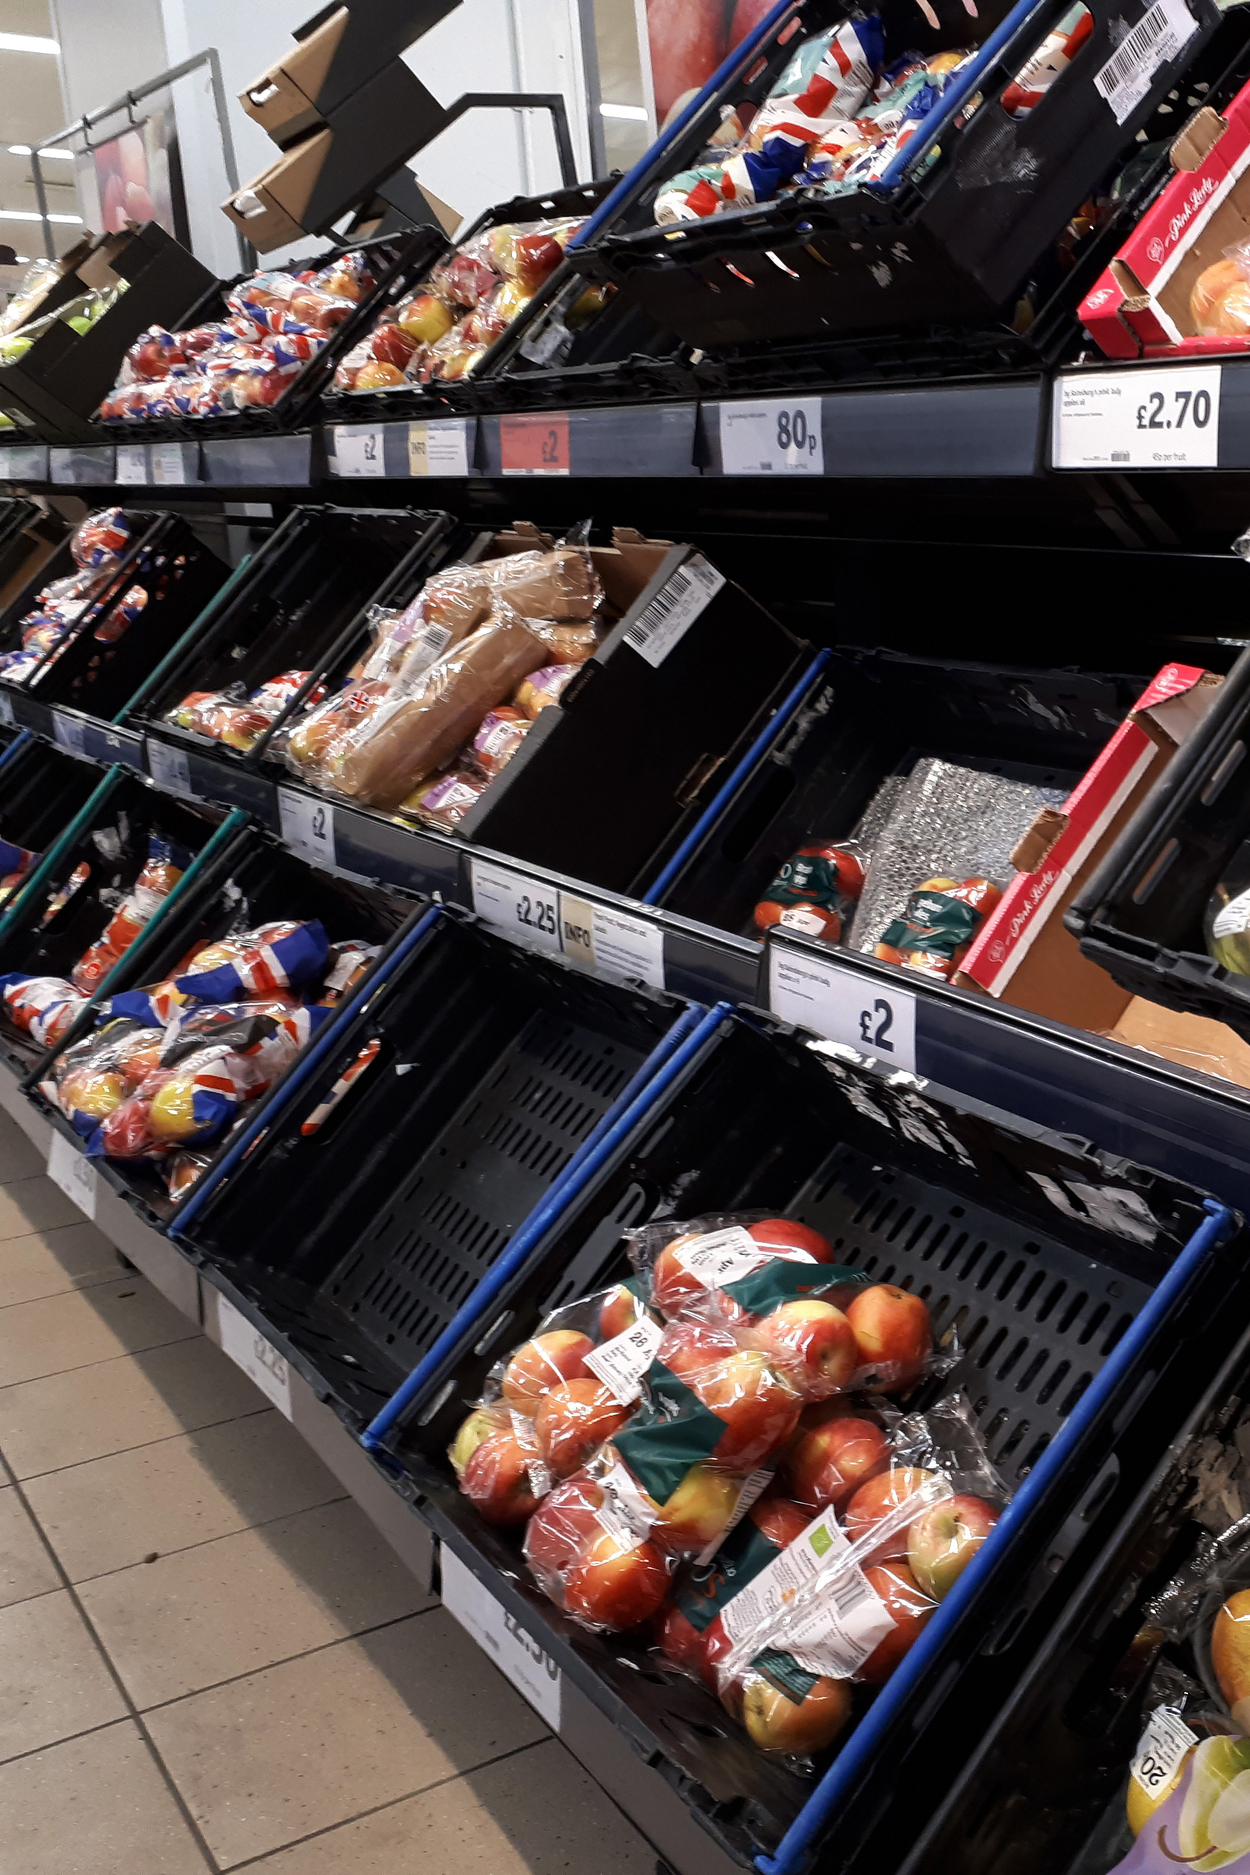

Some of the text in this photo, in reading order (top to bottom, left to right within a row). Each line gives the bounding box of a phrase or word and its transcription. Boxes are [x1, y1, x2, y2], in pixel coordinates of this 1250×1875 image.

[1166, 177, 1219, 247] Pink Lady
[1136, 389, 1211, 429] £2.70
[364, 433, 377, 461] £2
[541, 430, 559, 463] £2
[778, 409, 817, 456] 80p
[313, 807, 326, 841] £2
[517, 895, 556, 936] £2.25
[1005, 868, 1061, 946] Pink Lady
[564, 921, 591, 949] INFO
[859, 998, 894, 1053] £2
[628, 1331, 649, 1348] 28
[1140, 1755, 1168, 1787] 20
